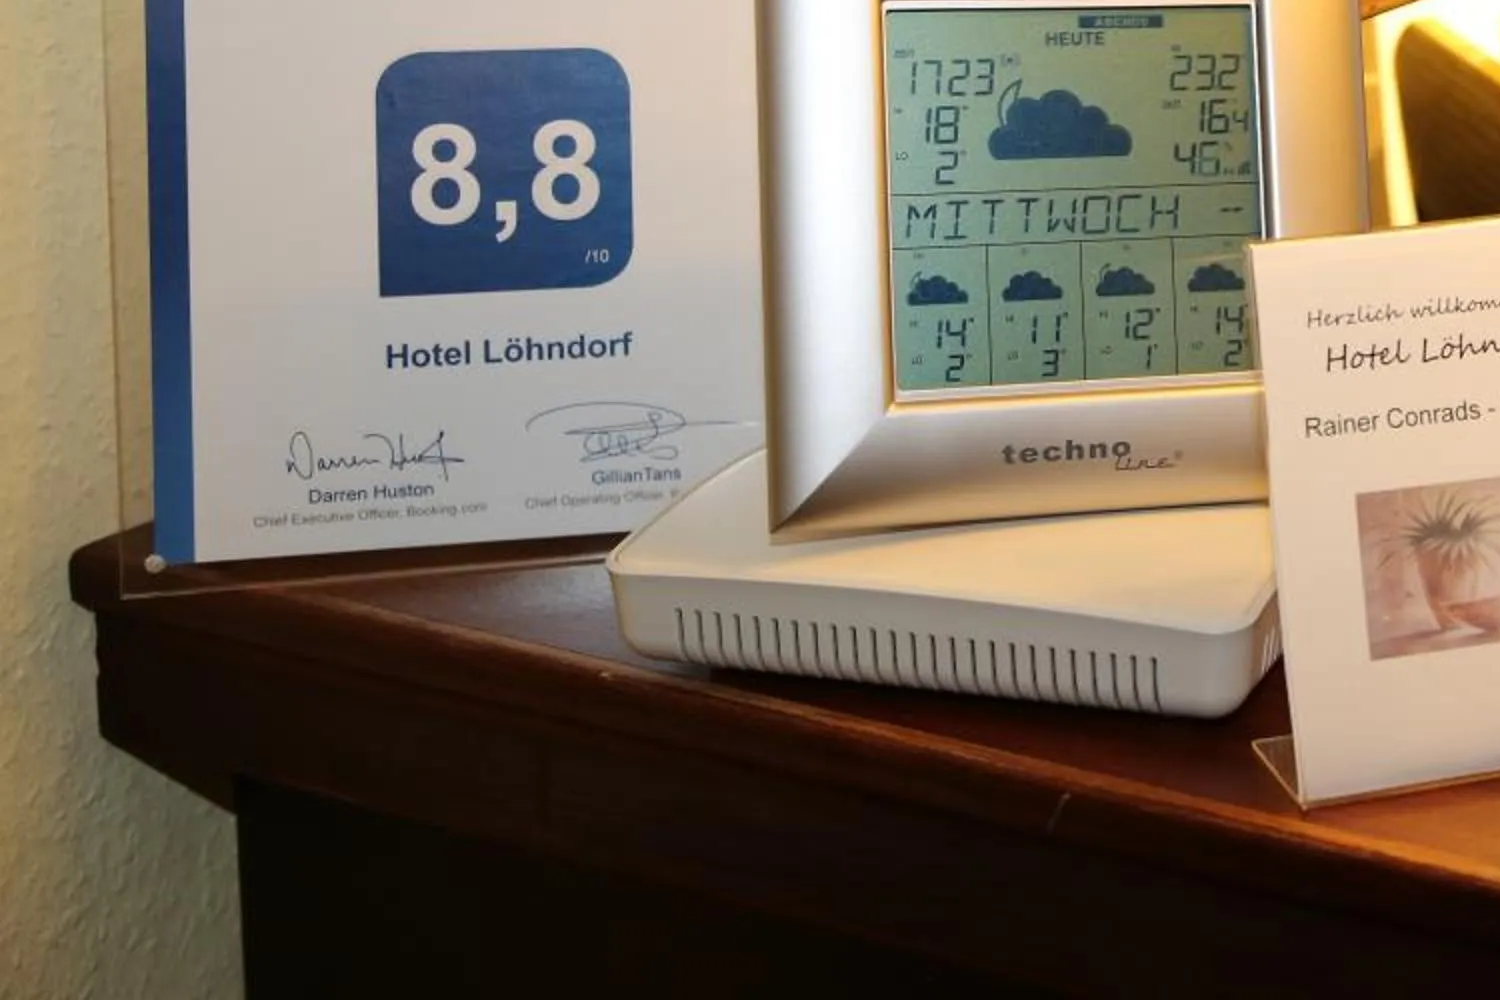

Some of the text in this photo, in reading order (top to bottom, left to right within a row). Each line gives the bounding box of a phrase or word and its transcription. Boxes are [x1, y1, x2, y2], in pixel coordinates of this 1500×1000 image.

[1045, 31, 1105, 47] HEUTE
[411, 118, 601, 243] 8,8
[906, 195, 1180, 240] MITTWOCH
[585, 249, 609, 264] /10
[1306, 303, 1401, 329] Herzlich
[386, 331, 634, 370] Hotel Löhndorf
[1326, 338, 1412, 373] Hotel
[1305, 413, 1381, 439] Rainer
[1386, 401, 1482, 430] Conrads
[1002, 439, 1131, 464] techno
[308, 482, 435, 505] Darren Huston
